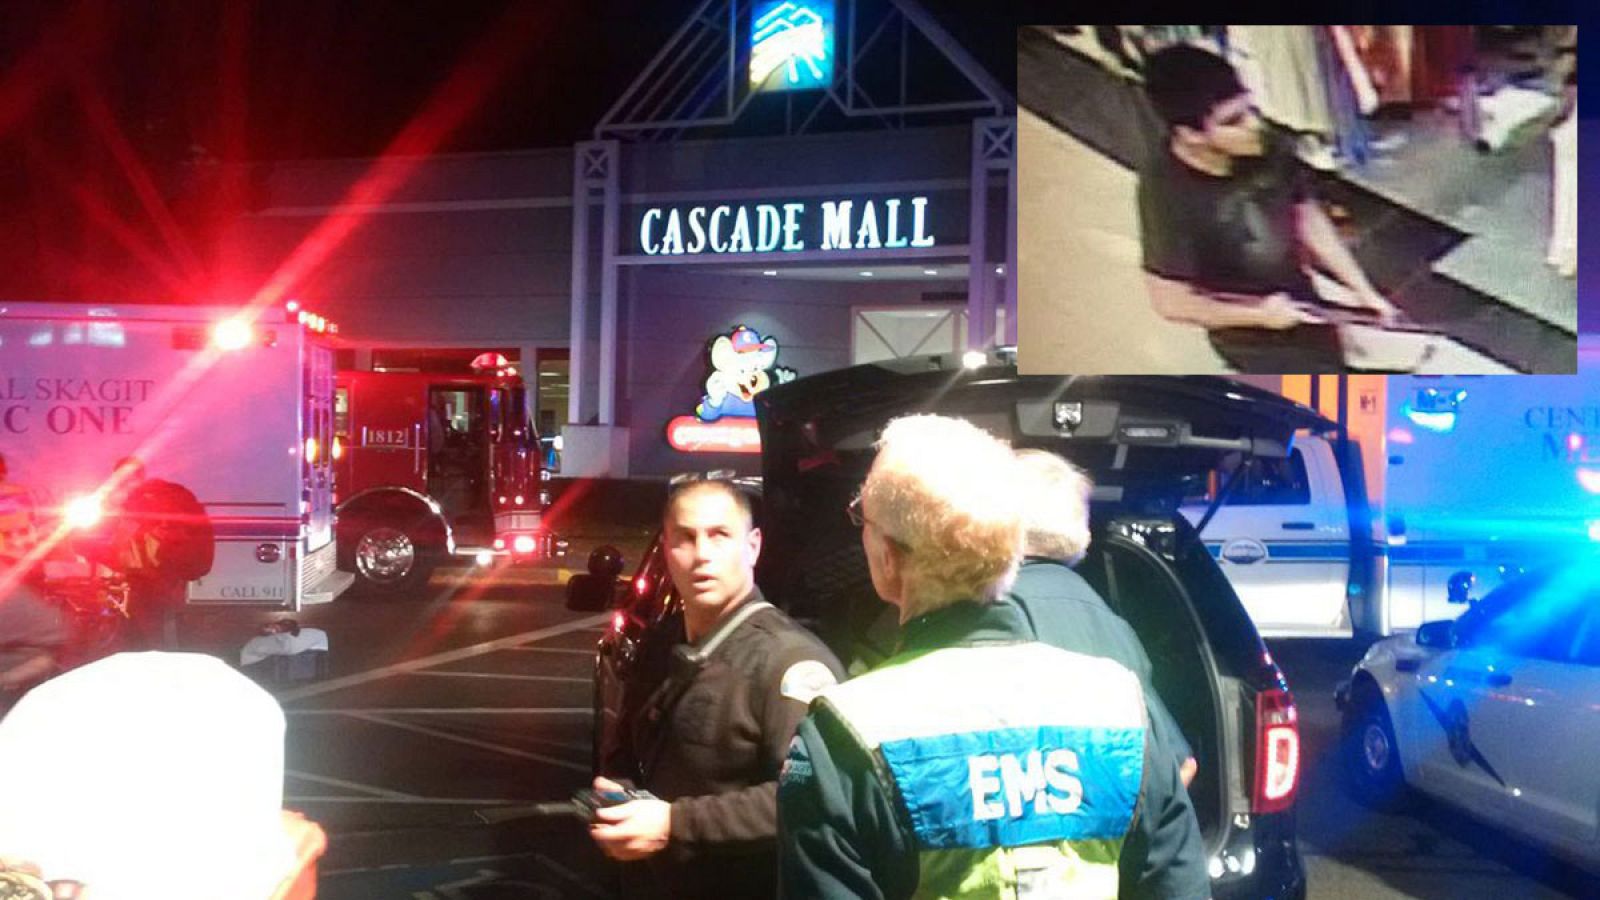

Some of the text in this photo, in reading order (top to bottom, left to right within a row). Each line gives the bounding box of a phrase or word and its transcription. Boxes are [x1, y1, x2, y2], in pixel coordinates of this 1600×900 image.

[640, 196, 936, 255] CASCADE MALL
[35, 378, 154, 402] SKAGIT
[47, 405, 134, 434] ONE
[368, 430, 404, 443] 1812
[220, 586, 283, 597] CALL 911
[968, 748, 1084, 820] EMS
